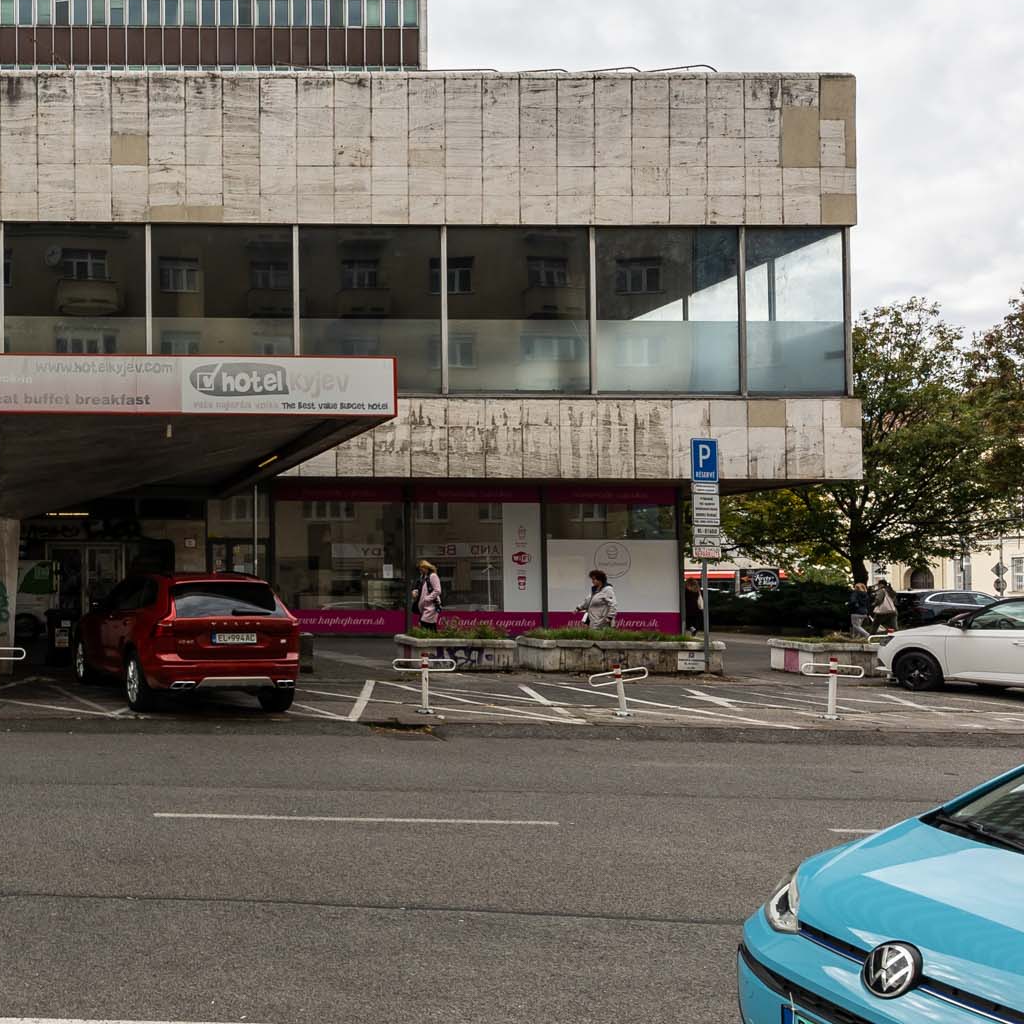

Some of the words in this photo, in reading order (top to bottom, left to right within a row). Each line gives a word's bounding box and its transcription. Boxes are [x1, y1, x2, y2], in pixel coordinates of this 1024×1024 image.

[222, 369, 284, 393] hotel
[24, 393, 70, 405] buffet
[75, 393, 151, 406] breakfast
[282, 402, 296, 410] The
[298, 402, 316, 410] Best
[698, 444, 711, 468] P
